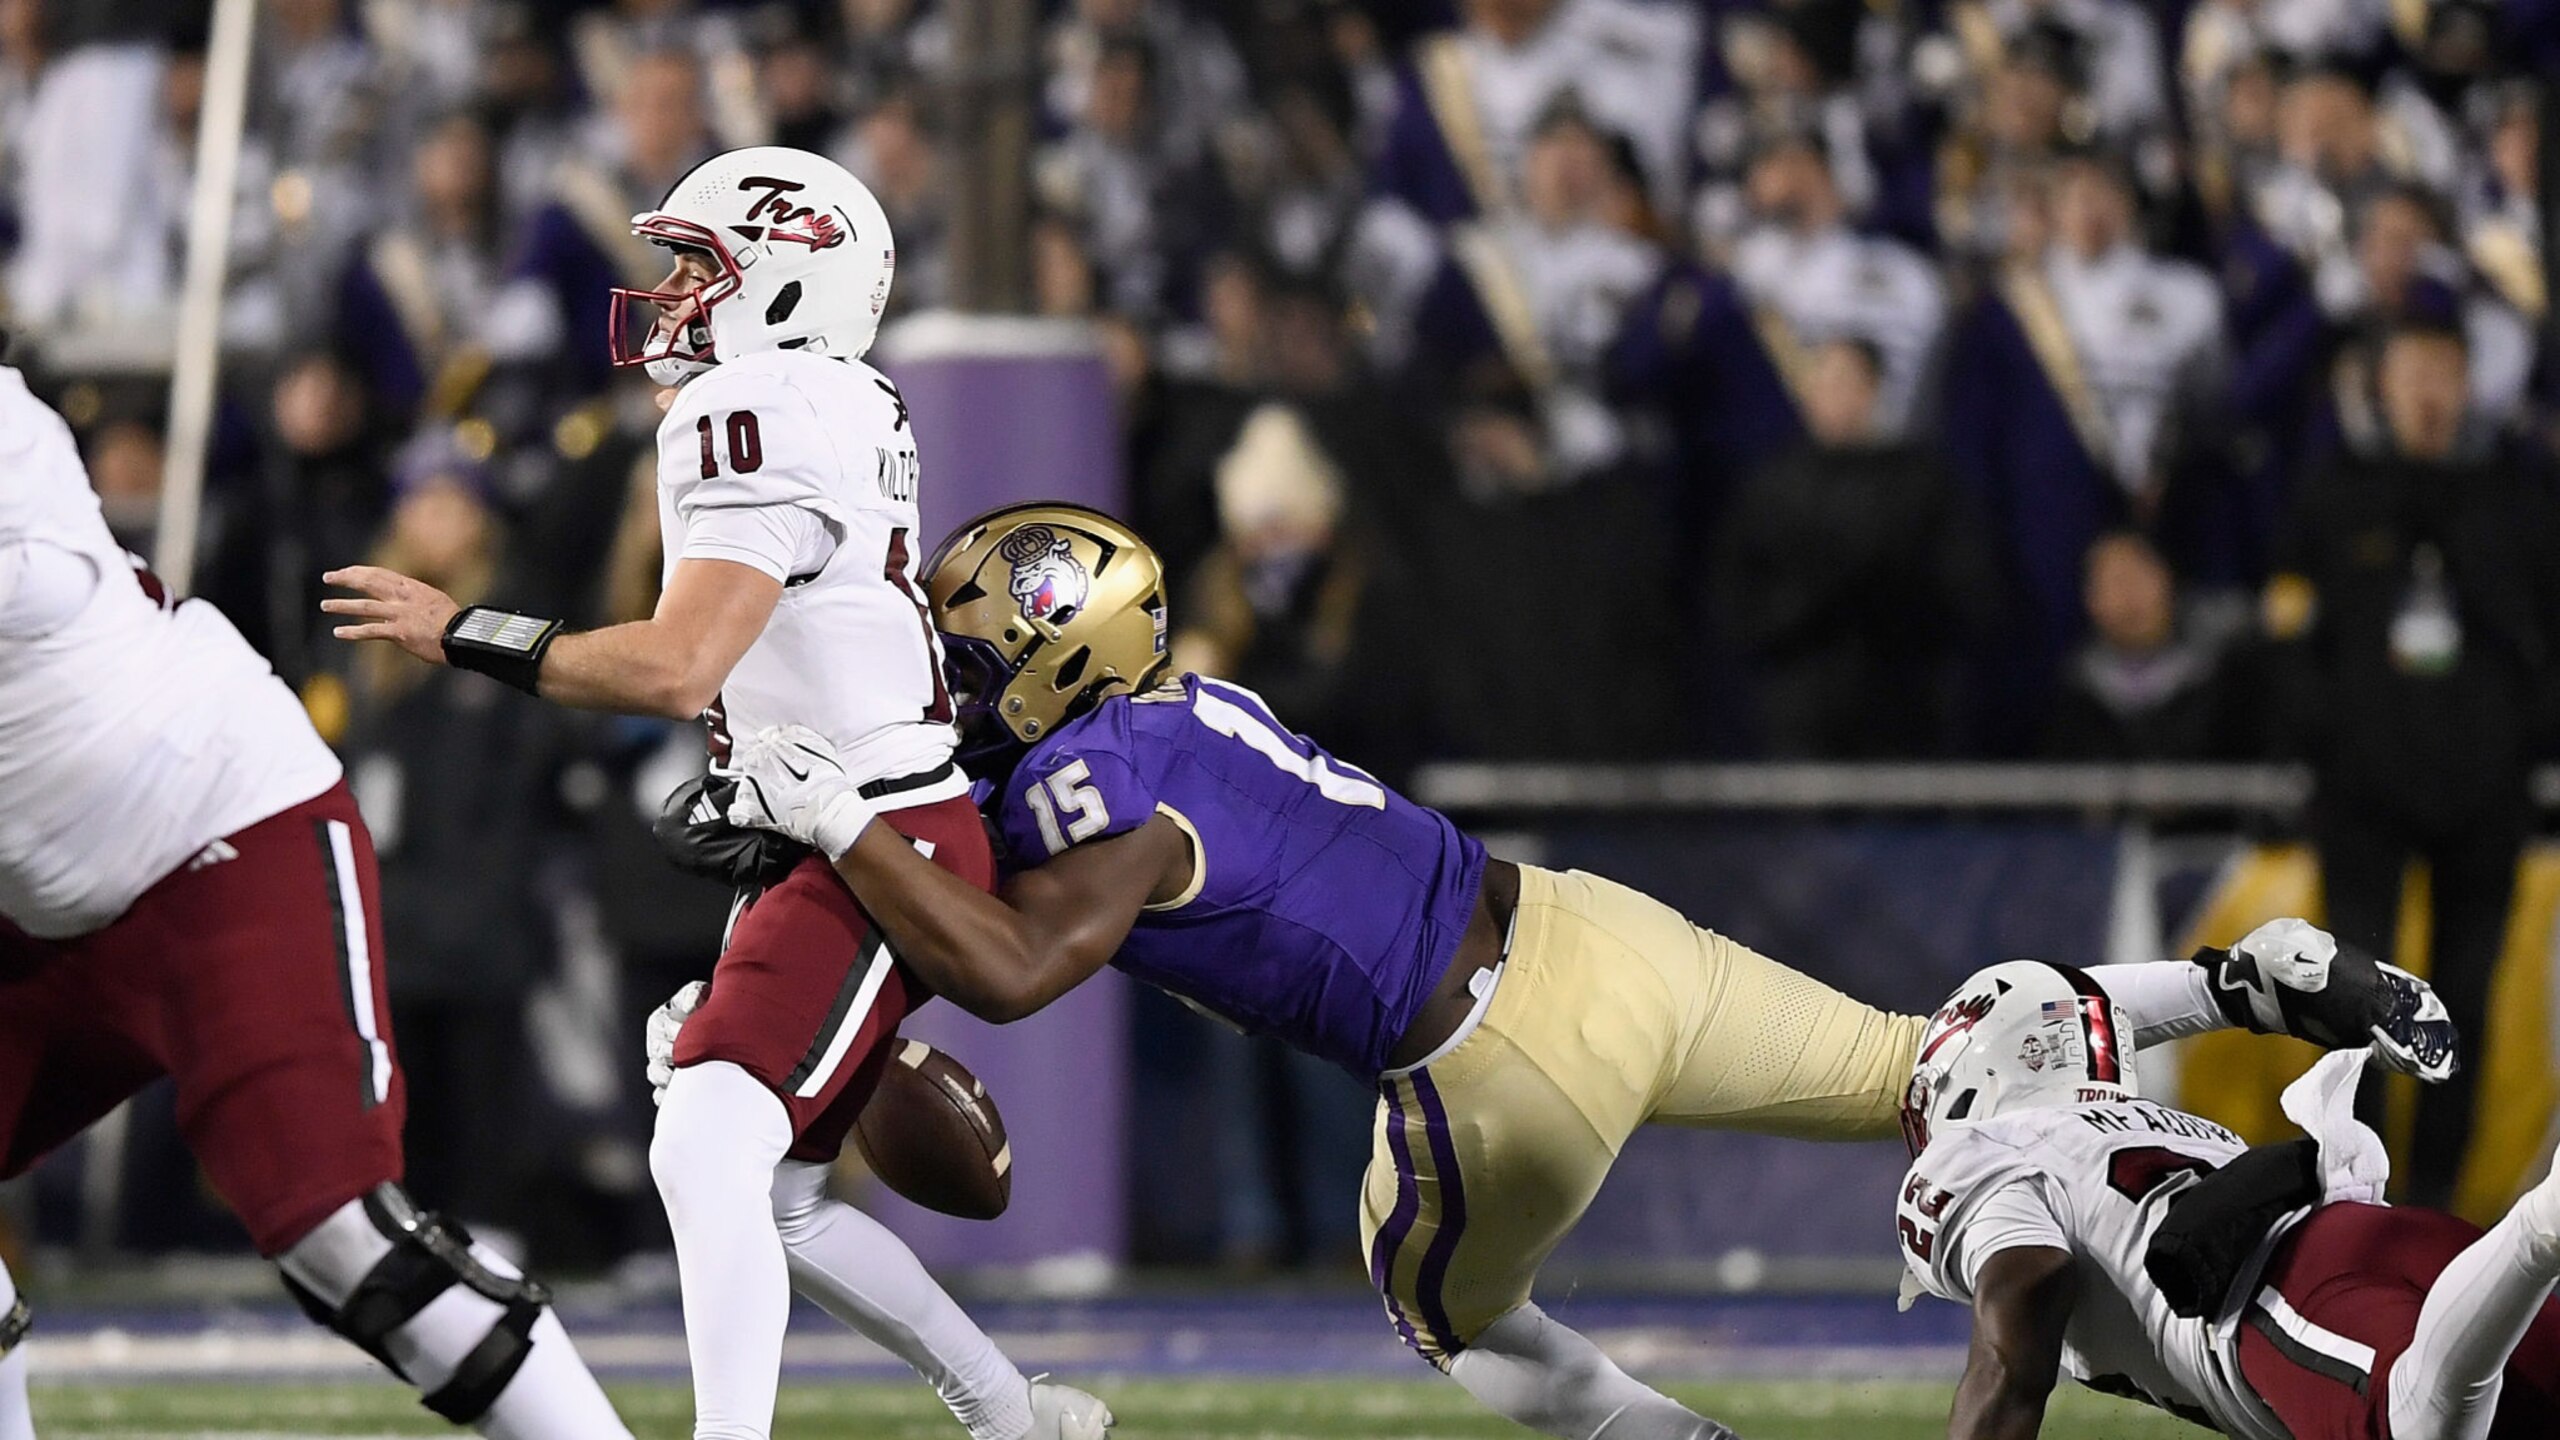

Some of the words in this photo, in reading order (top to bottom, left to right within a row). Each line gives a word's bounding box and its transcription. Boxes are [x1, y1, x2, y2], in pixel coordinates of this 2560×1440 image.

[729, 176, 846, 253] Troy
[696, 409, 763, 480] 10
[875, 446, 918, 504] KILCR
[1024, 758, 1111, 857] 15
[2075, 1087, 2130, 1104] TROJ
[1898, 1171, 1956, 1266] 22
